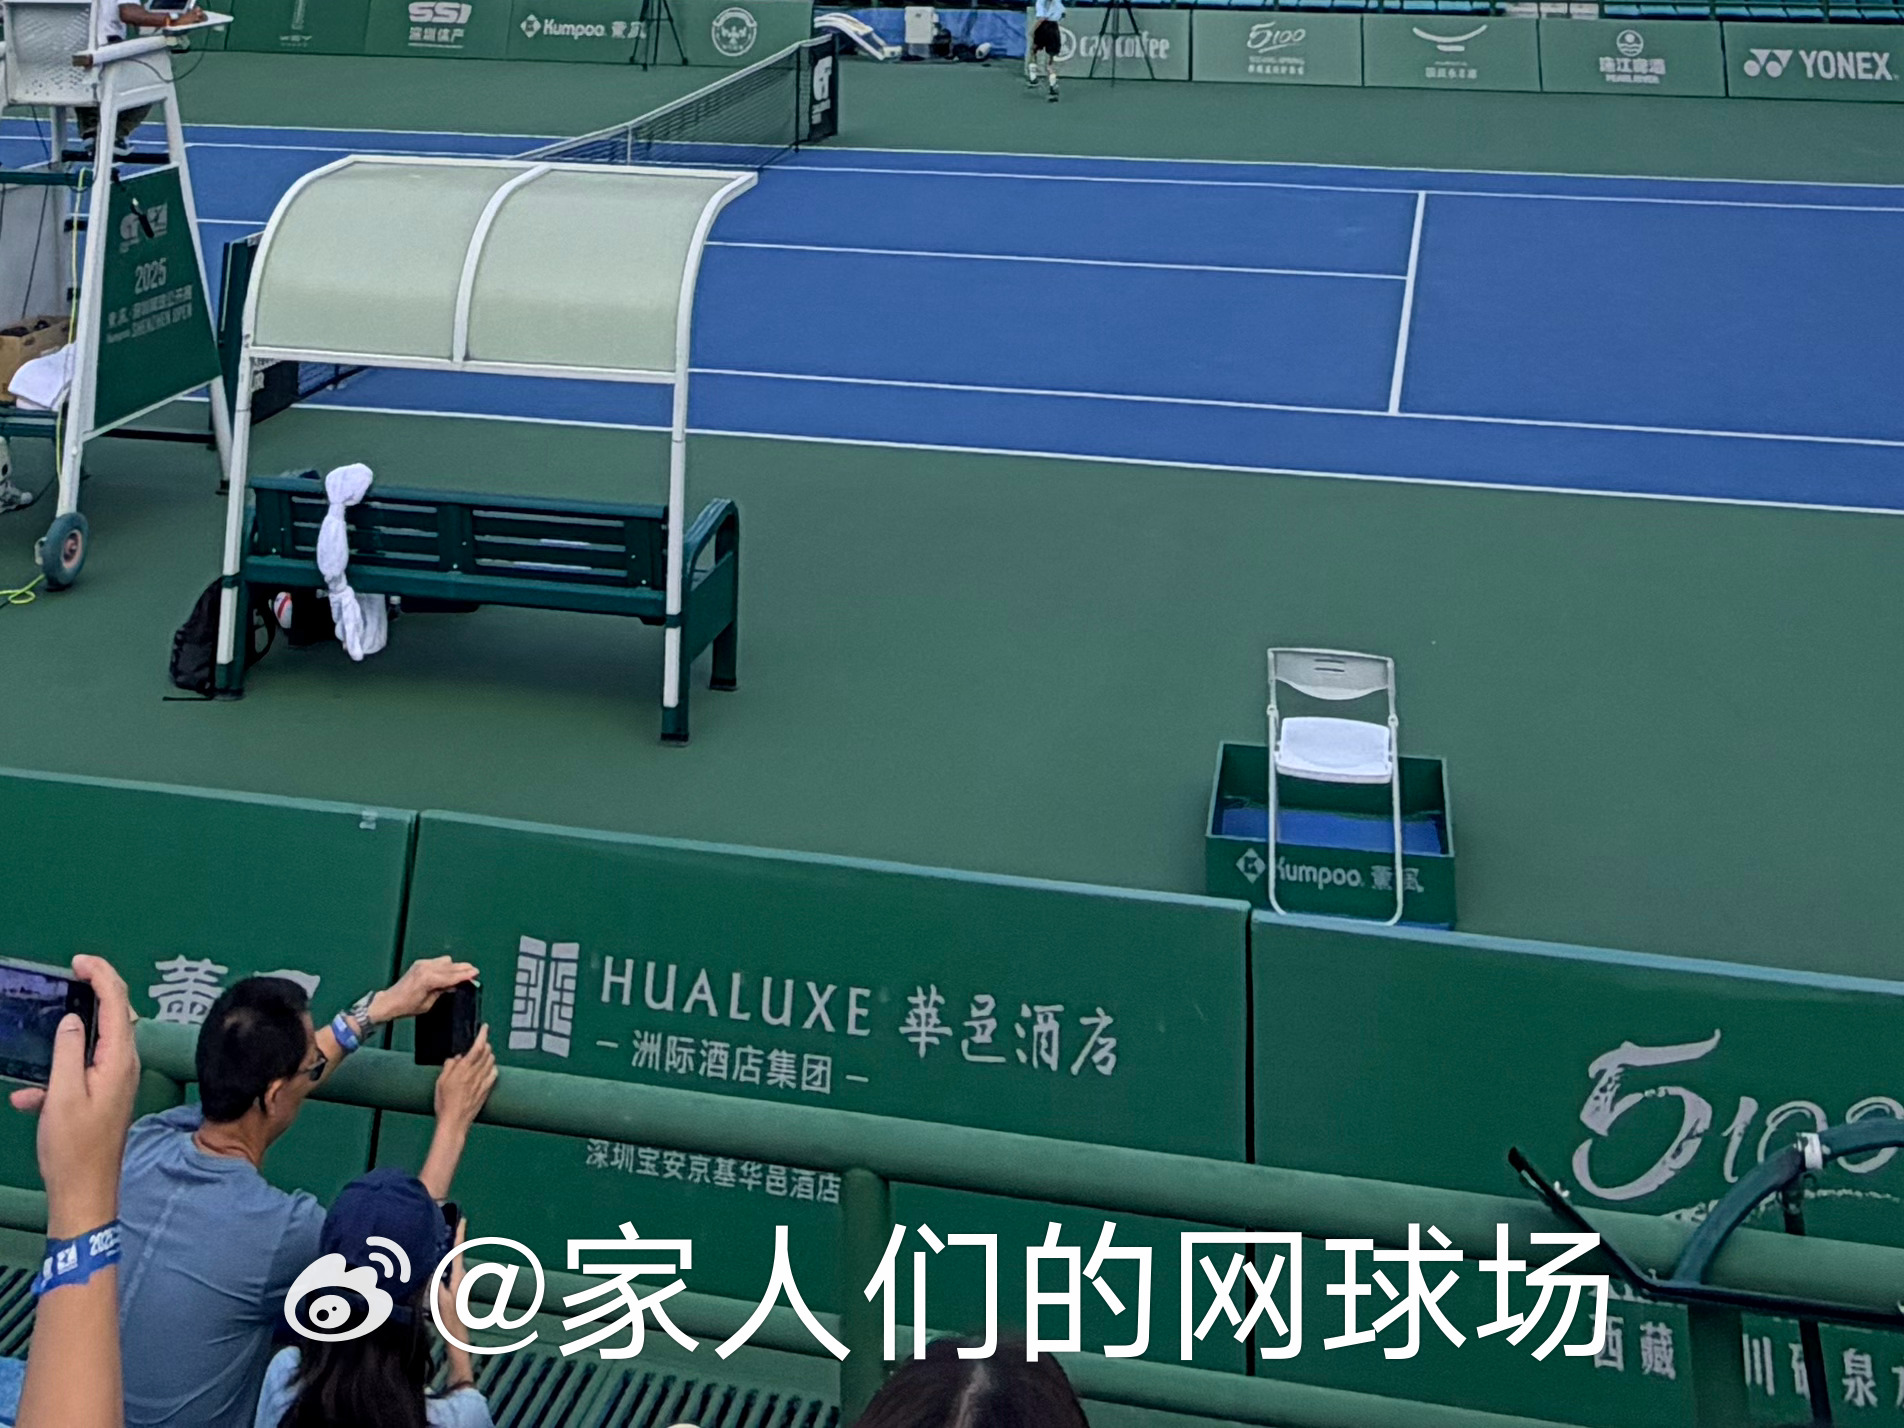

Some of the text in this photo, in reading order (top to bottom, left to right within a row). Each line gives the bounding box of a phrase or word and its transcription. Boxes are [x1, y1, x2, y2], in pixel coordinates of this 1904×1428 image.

[543, 18, 606, 40] Kumpoo
[1247, 21, 1307, 50] 5100
[1798, 49, 1894, 82] YONEX
[134, 257, 167, 295] 2025
[601, 955, 871, 1037] HUALUXE
[631, 1029, 833, 1095] 洲际酒店集团
[586, 1138, 842, 1204] 深圳宝安京基华邑酒店
